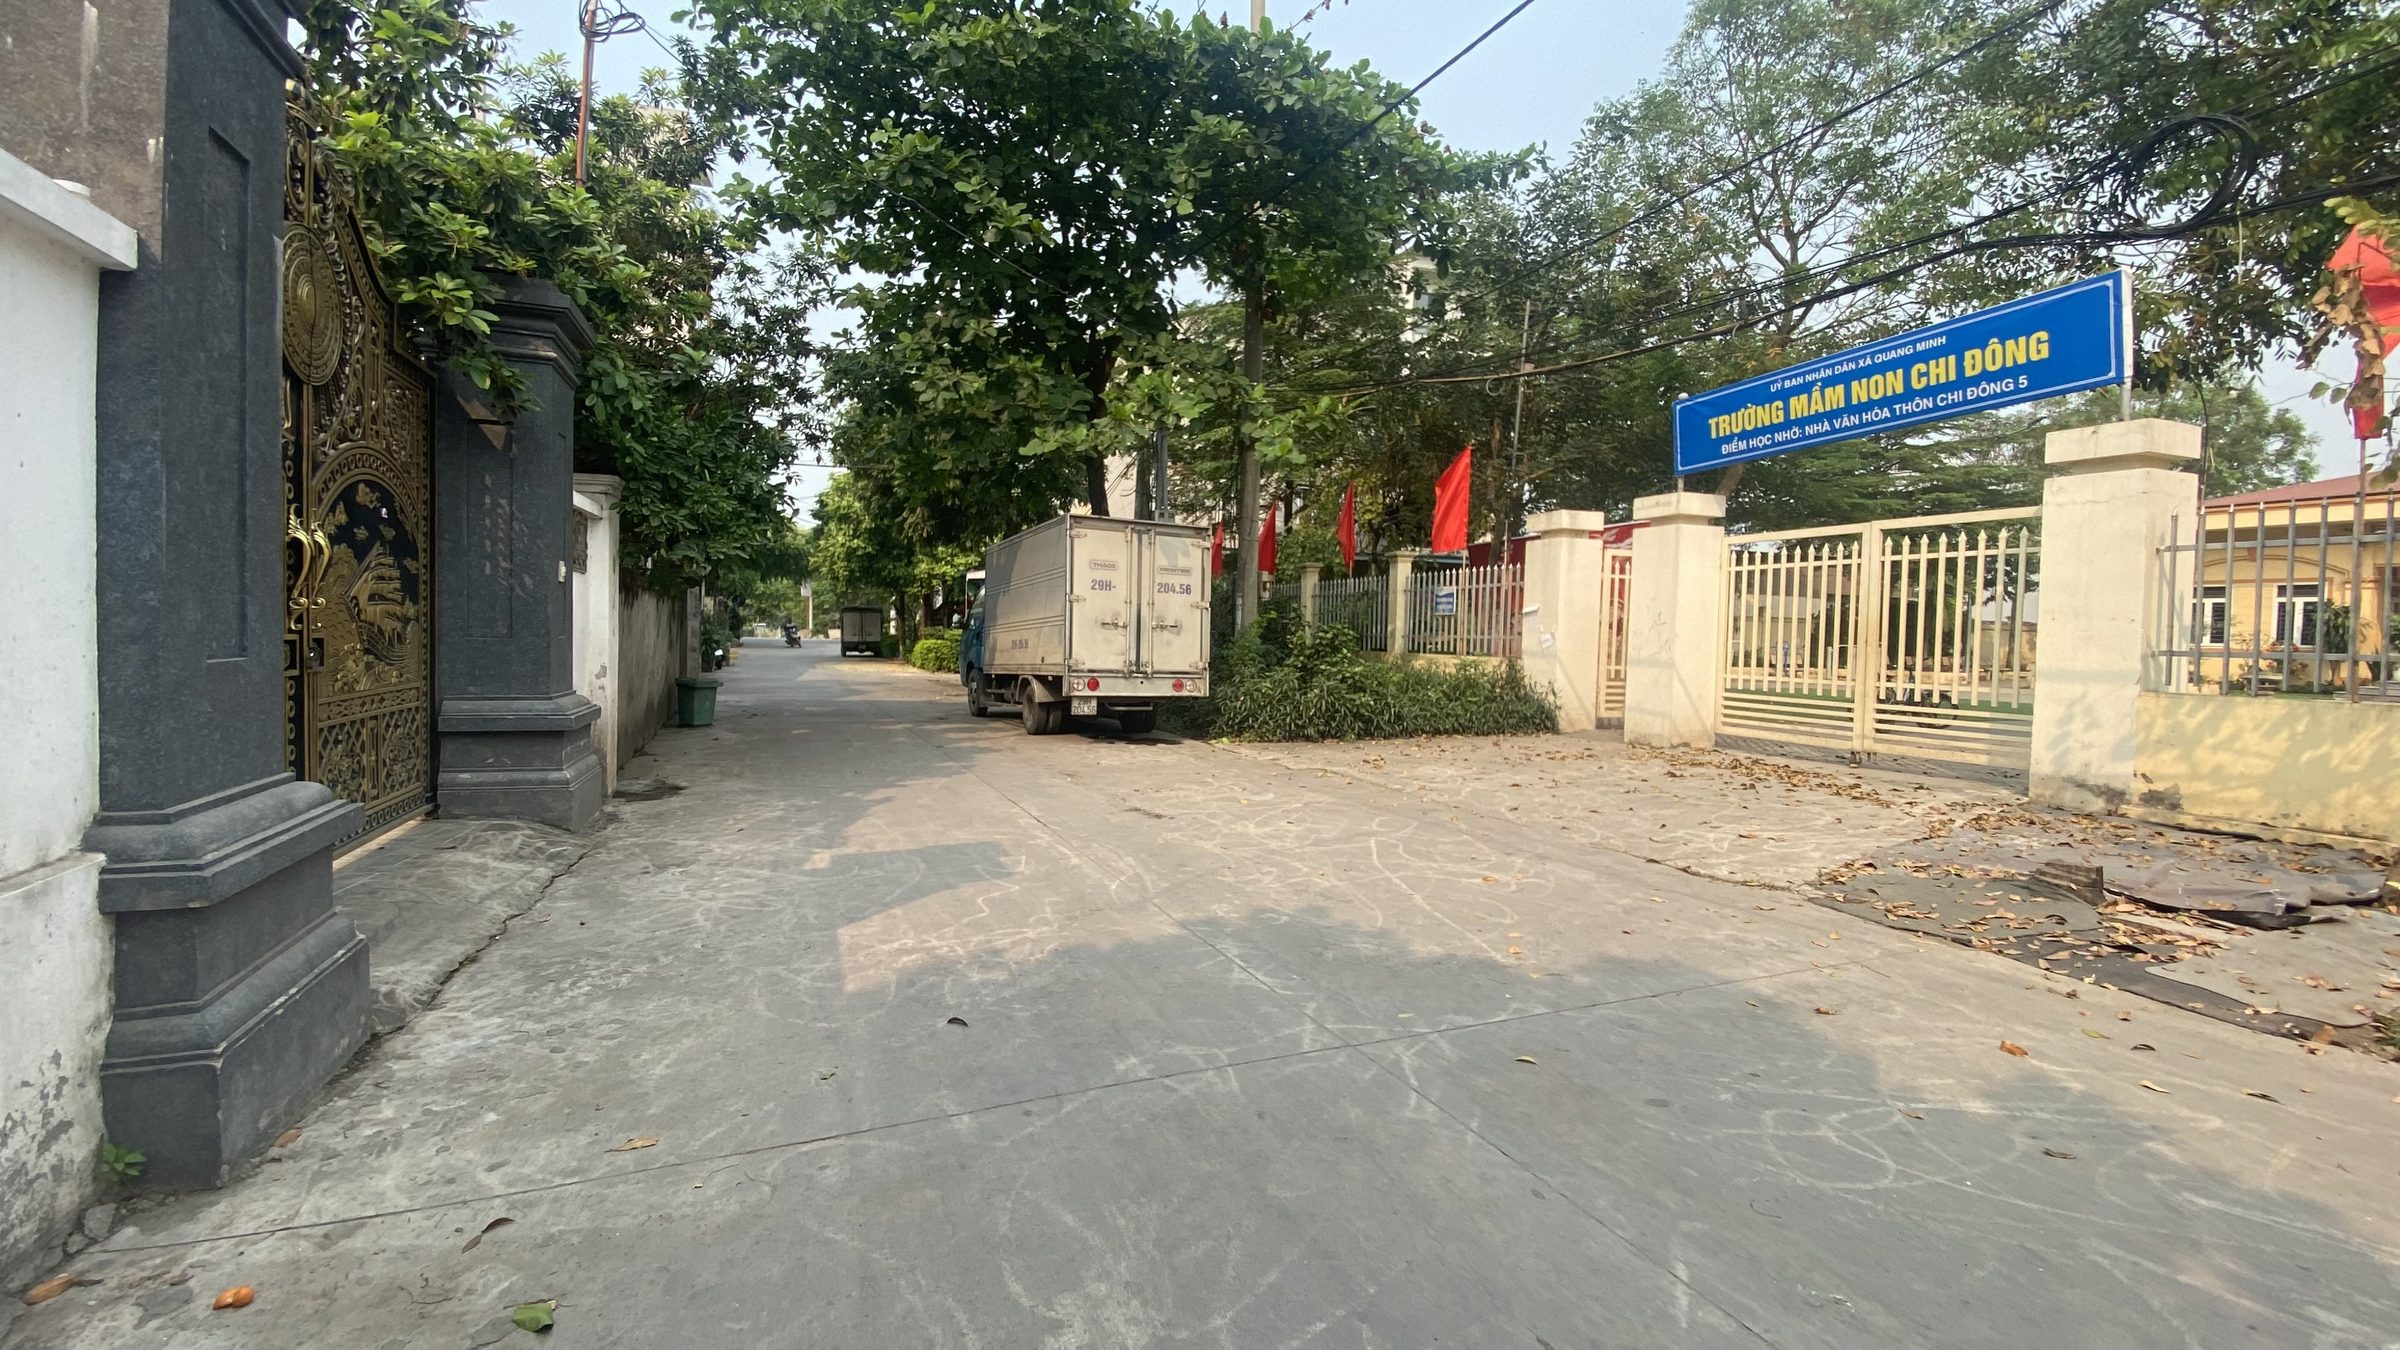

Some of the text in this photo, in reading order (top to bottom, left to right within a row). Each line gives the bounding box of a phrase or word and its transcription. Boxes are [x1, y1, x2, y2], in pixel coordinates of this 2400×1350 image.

[1708, 331, 2050, 439] TRƯỜNG MẦM NON CHI ĐÔNG
[1784, 377, 1804, 389] BAN
[1805, 368, 1833, 383] NHÂN
[1858, 355, 1873, 368] XÃ
[1874, 345, 1914, 364] QUANG
[1916, 335, 1947, 352] MINH
[1721, 375, 2029, 455] ĐIỂM HỌC NHỜ: NHÀ VĂN HÓA THÔN CHI ĐÔNG 5
[1090, 578, 1192, 595] 29H- 204.56
